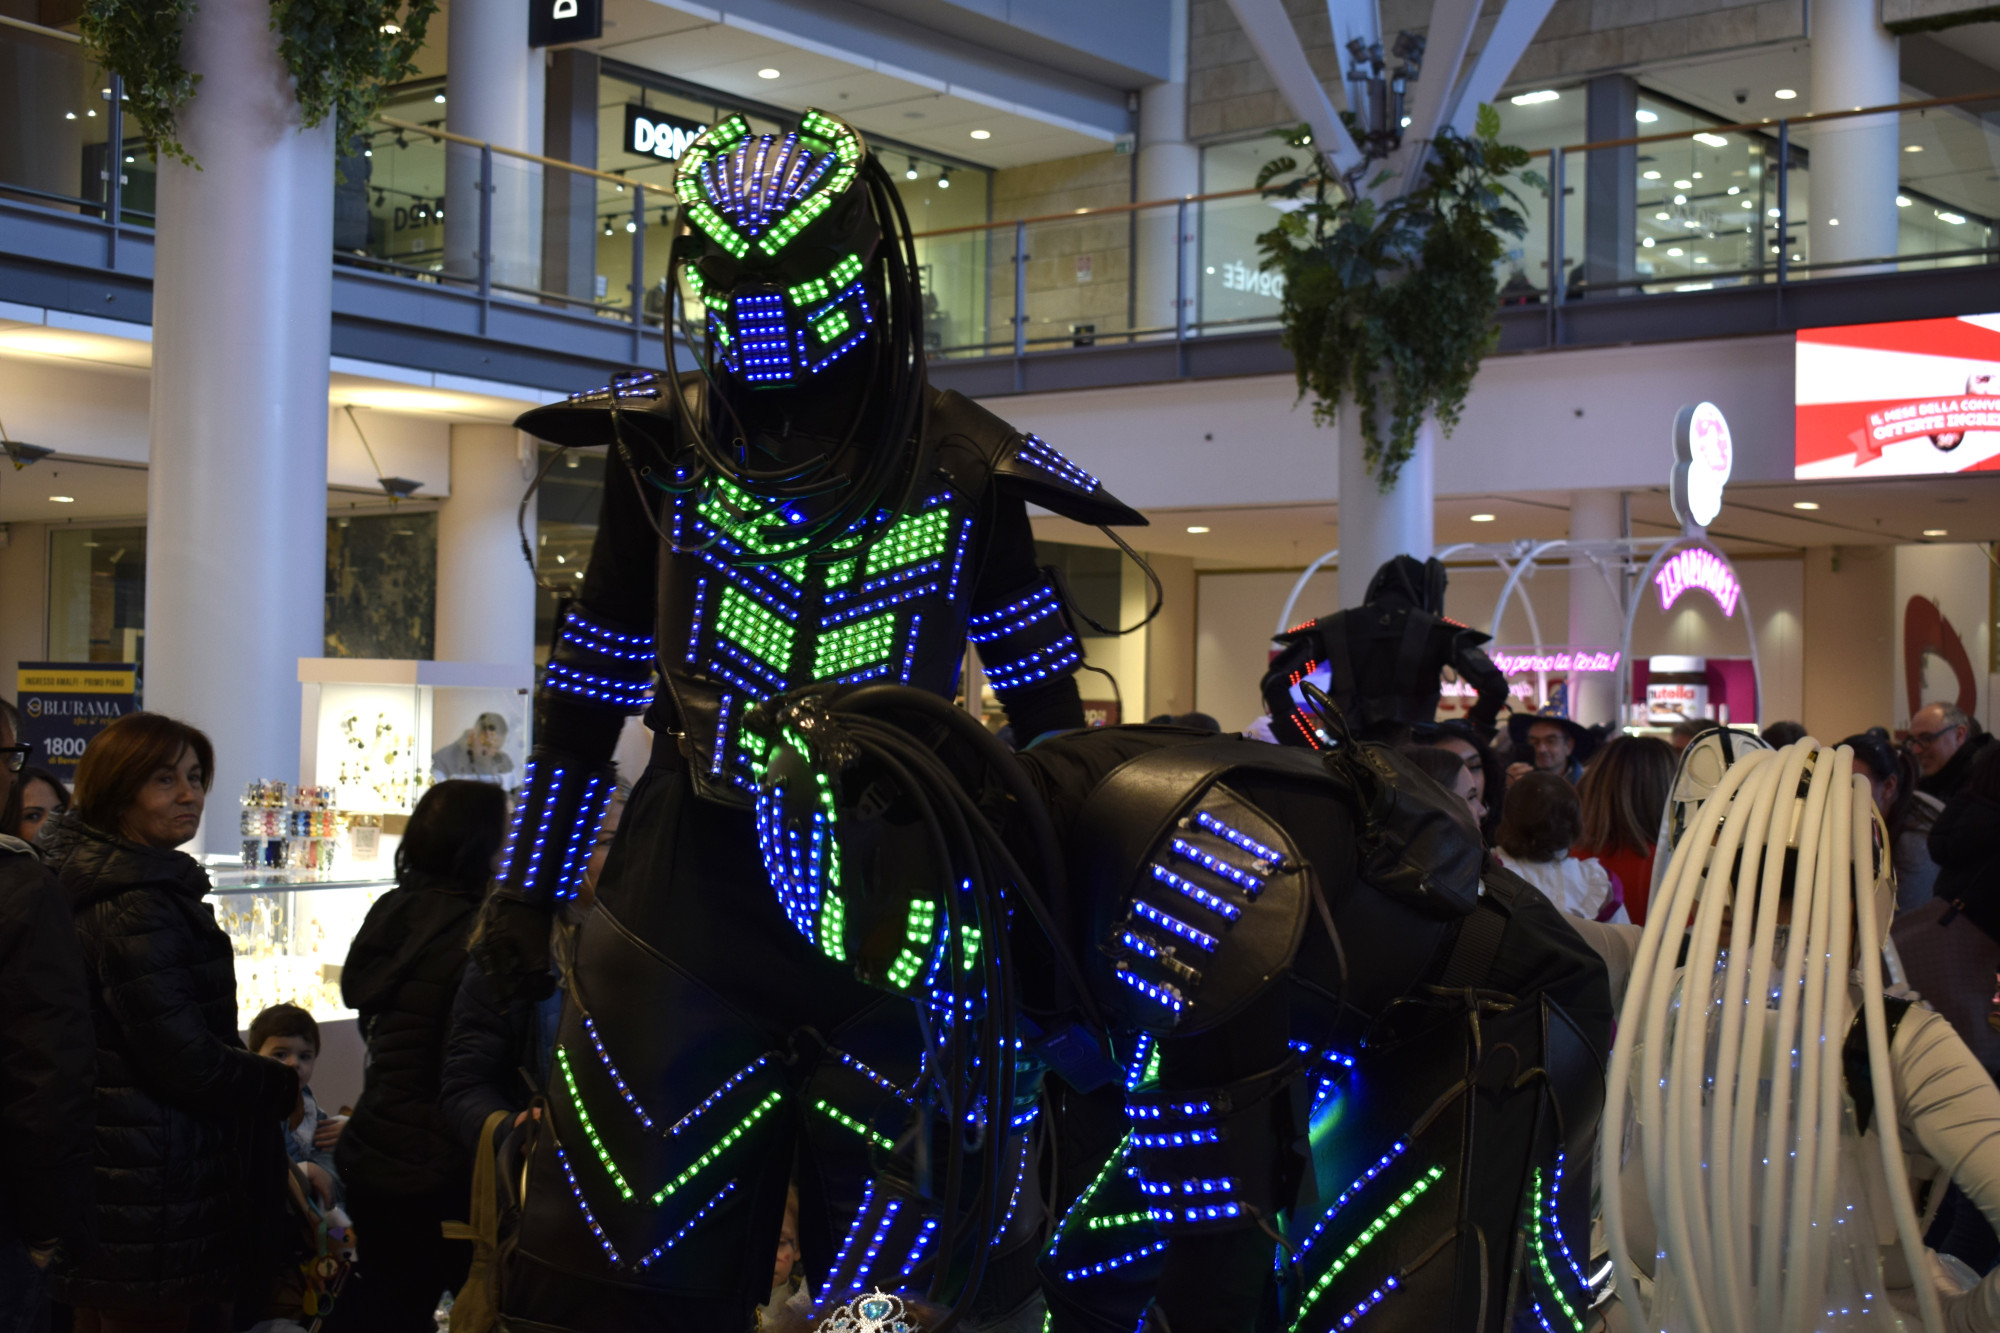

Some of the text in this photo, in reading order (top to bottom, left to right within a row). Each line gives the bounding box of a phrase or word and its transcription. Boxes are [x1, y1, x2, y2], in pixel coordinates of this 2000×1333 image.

[634, 117, 707, 160] DON
[1918, 400, 1959, 416] DELLA
[1873, 415, 1945, 440] OFFERTE
[1648, 685, 1696, 700] nutella
[43, 700, 121, 716] BLURAMA
[43, 738, 86, 756] 1800
